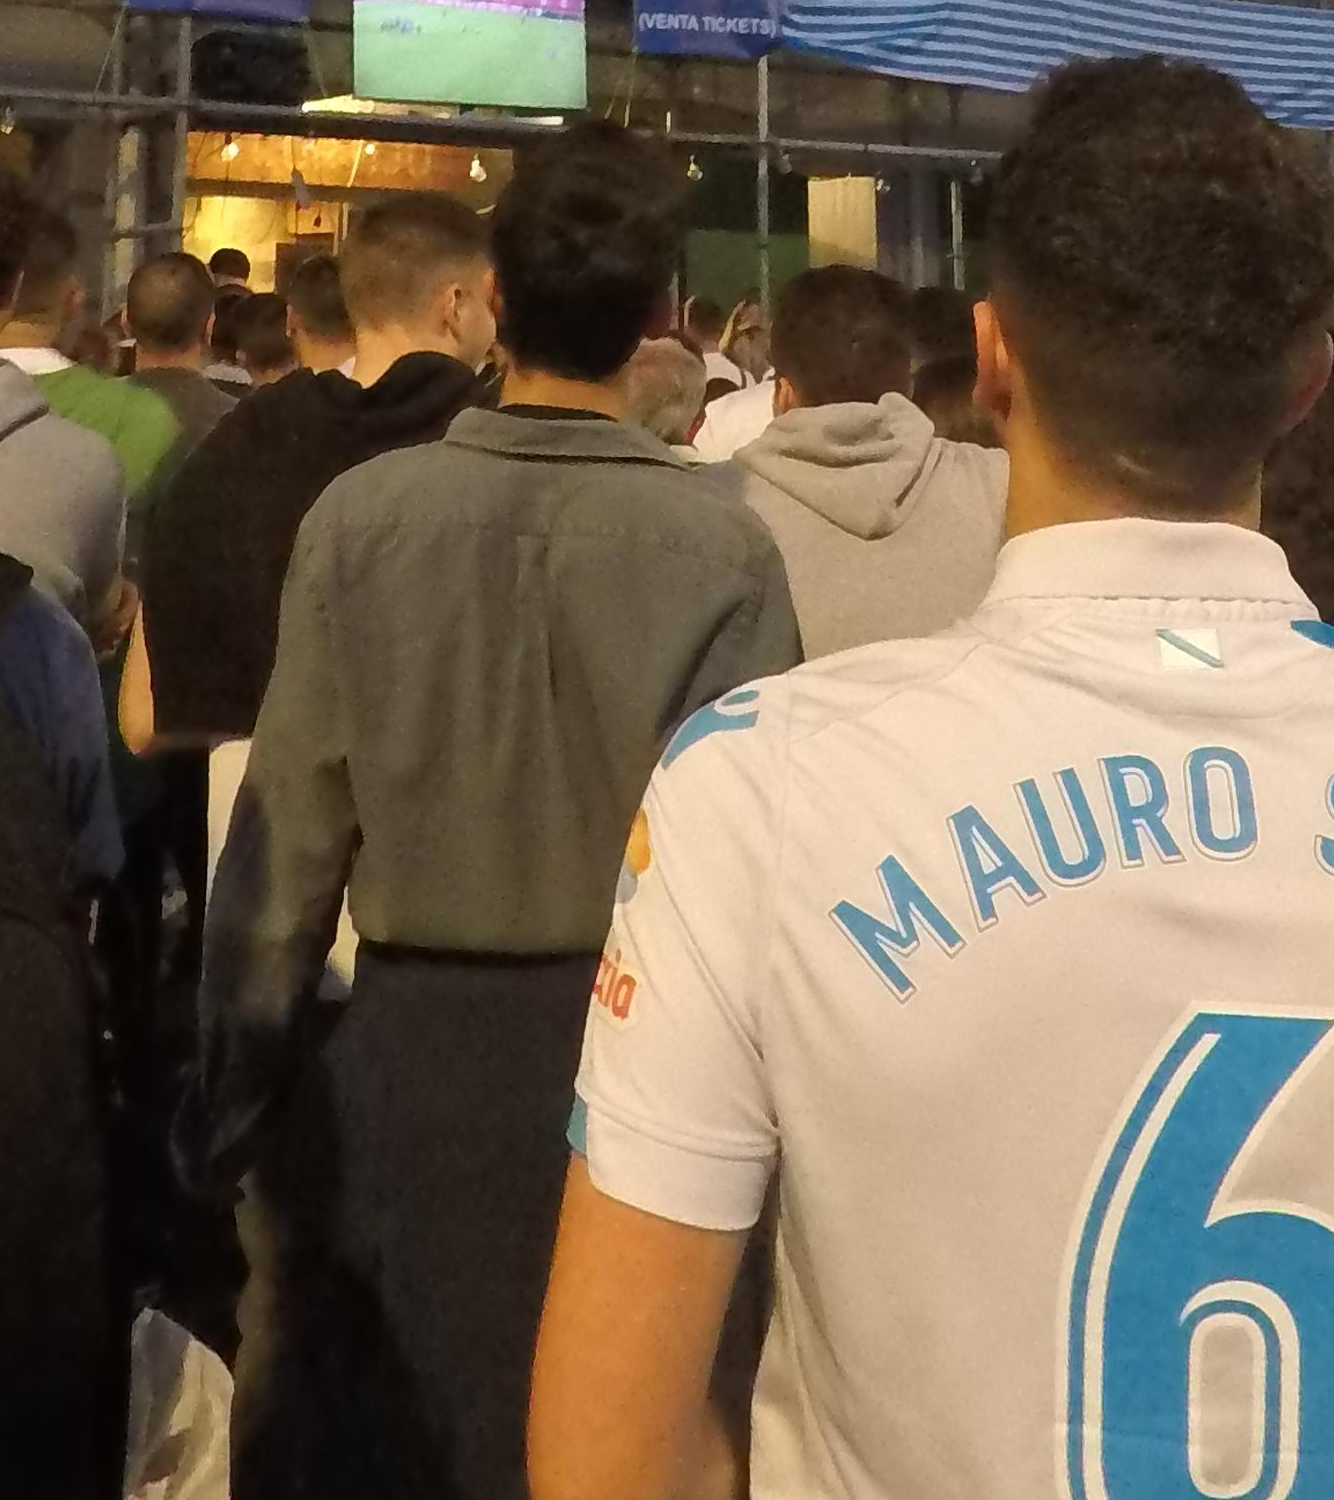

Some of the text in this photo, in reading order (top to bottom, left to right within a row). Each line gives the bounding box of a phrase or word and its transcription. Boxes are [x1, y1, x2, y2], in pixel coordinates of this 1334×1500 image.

[639, 12, 777, 39] (VENTA TICKETS)
[829, 746, 1259, 1003] MAURO
